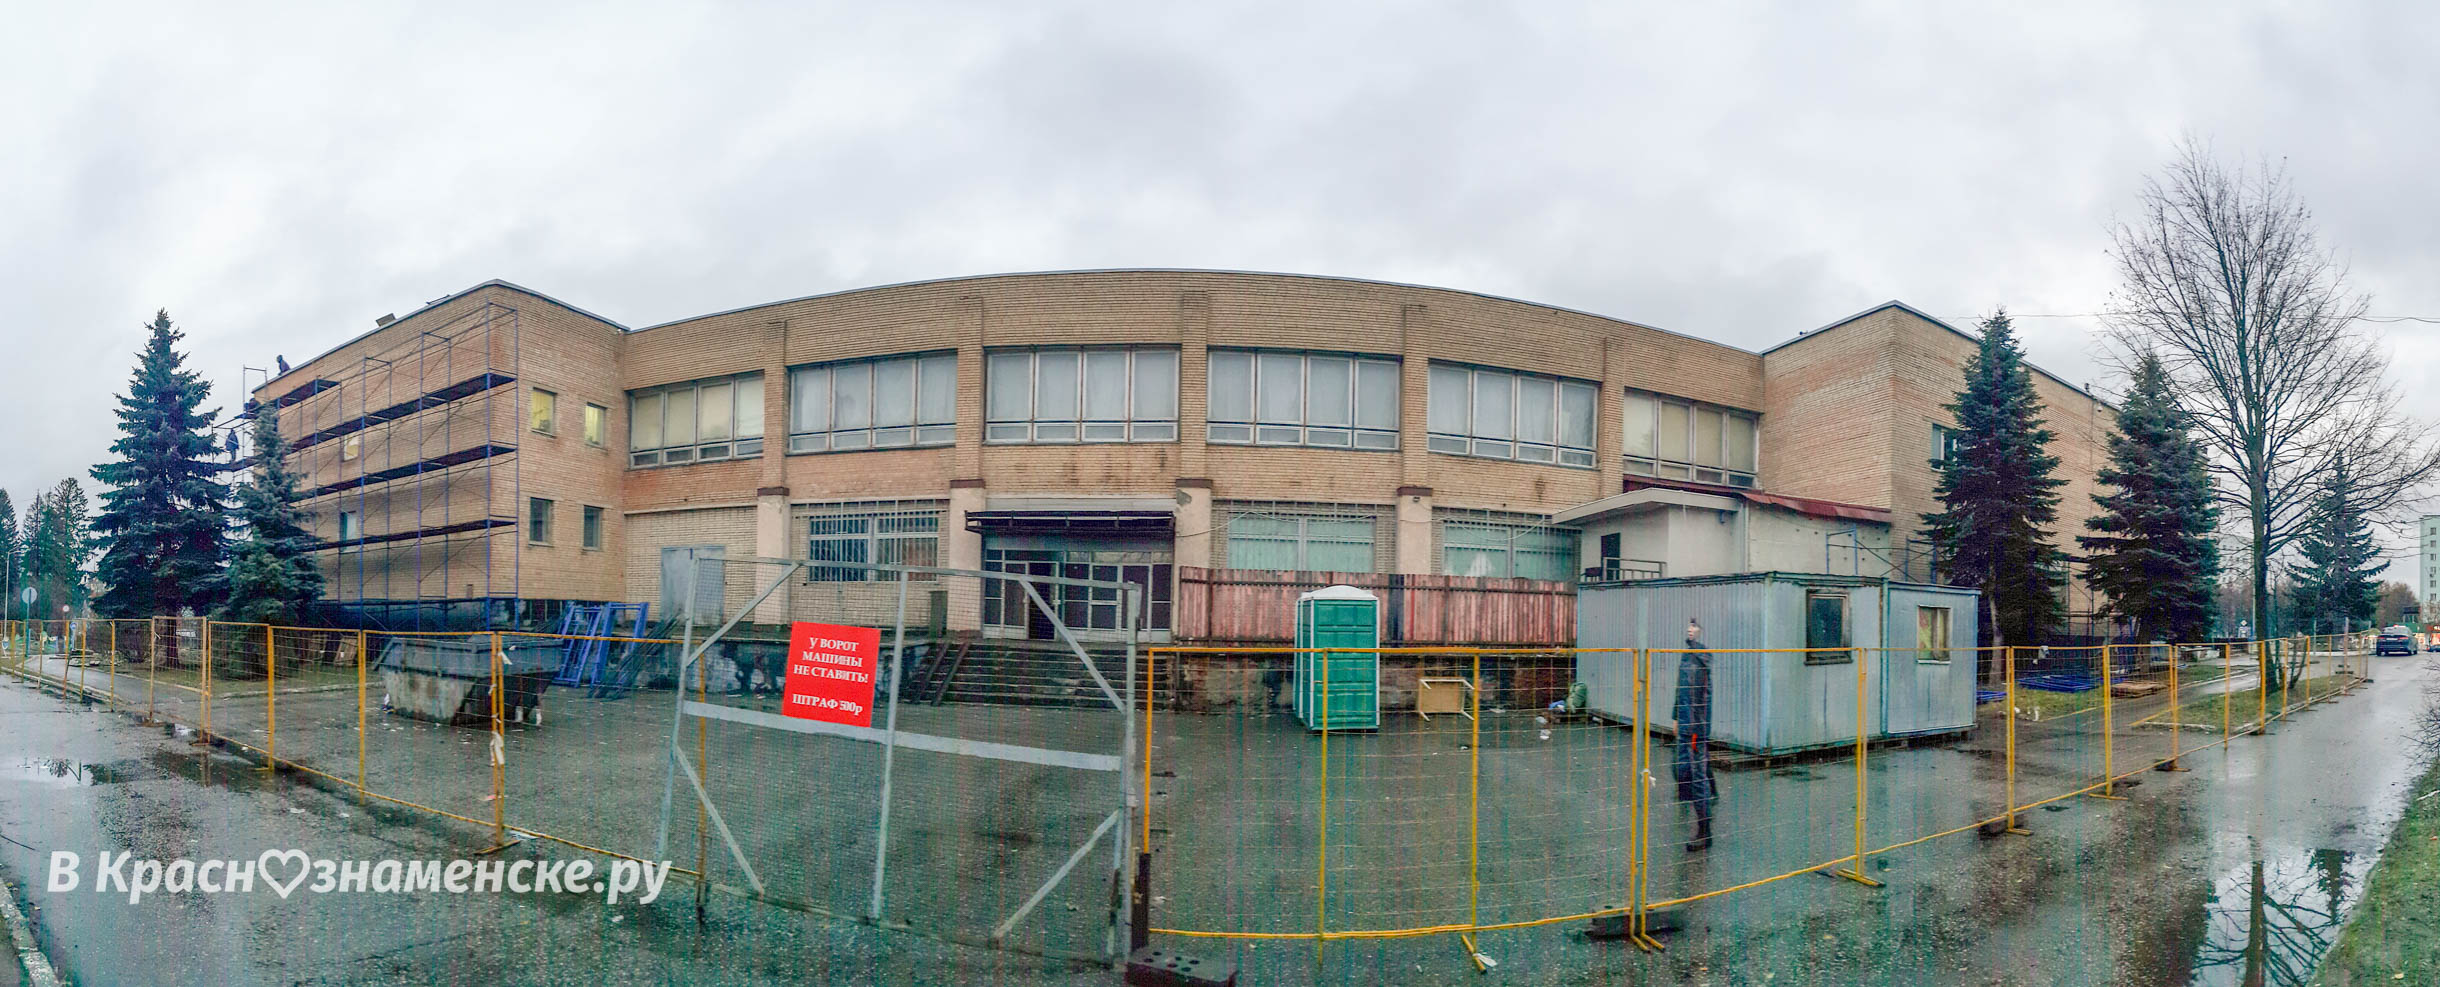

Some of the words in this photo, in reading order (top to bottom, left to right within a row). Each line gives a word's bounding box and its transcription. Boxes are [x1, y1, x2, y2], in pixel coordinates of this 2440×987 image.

[809, 637, 818, 649] У
[820, 639, 859, 652] ВОРОТ
[802, 651, 863, 668] МАШИНЫ
[793, 664, 809, 676] НЕ
[792, 693, 838, 709] ШТРАФ
